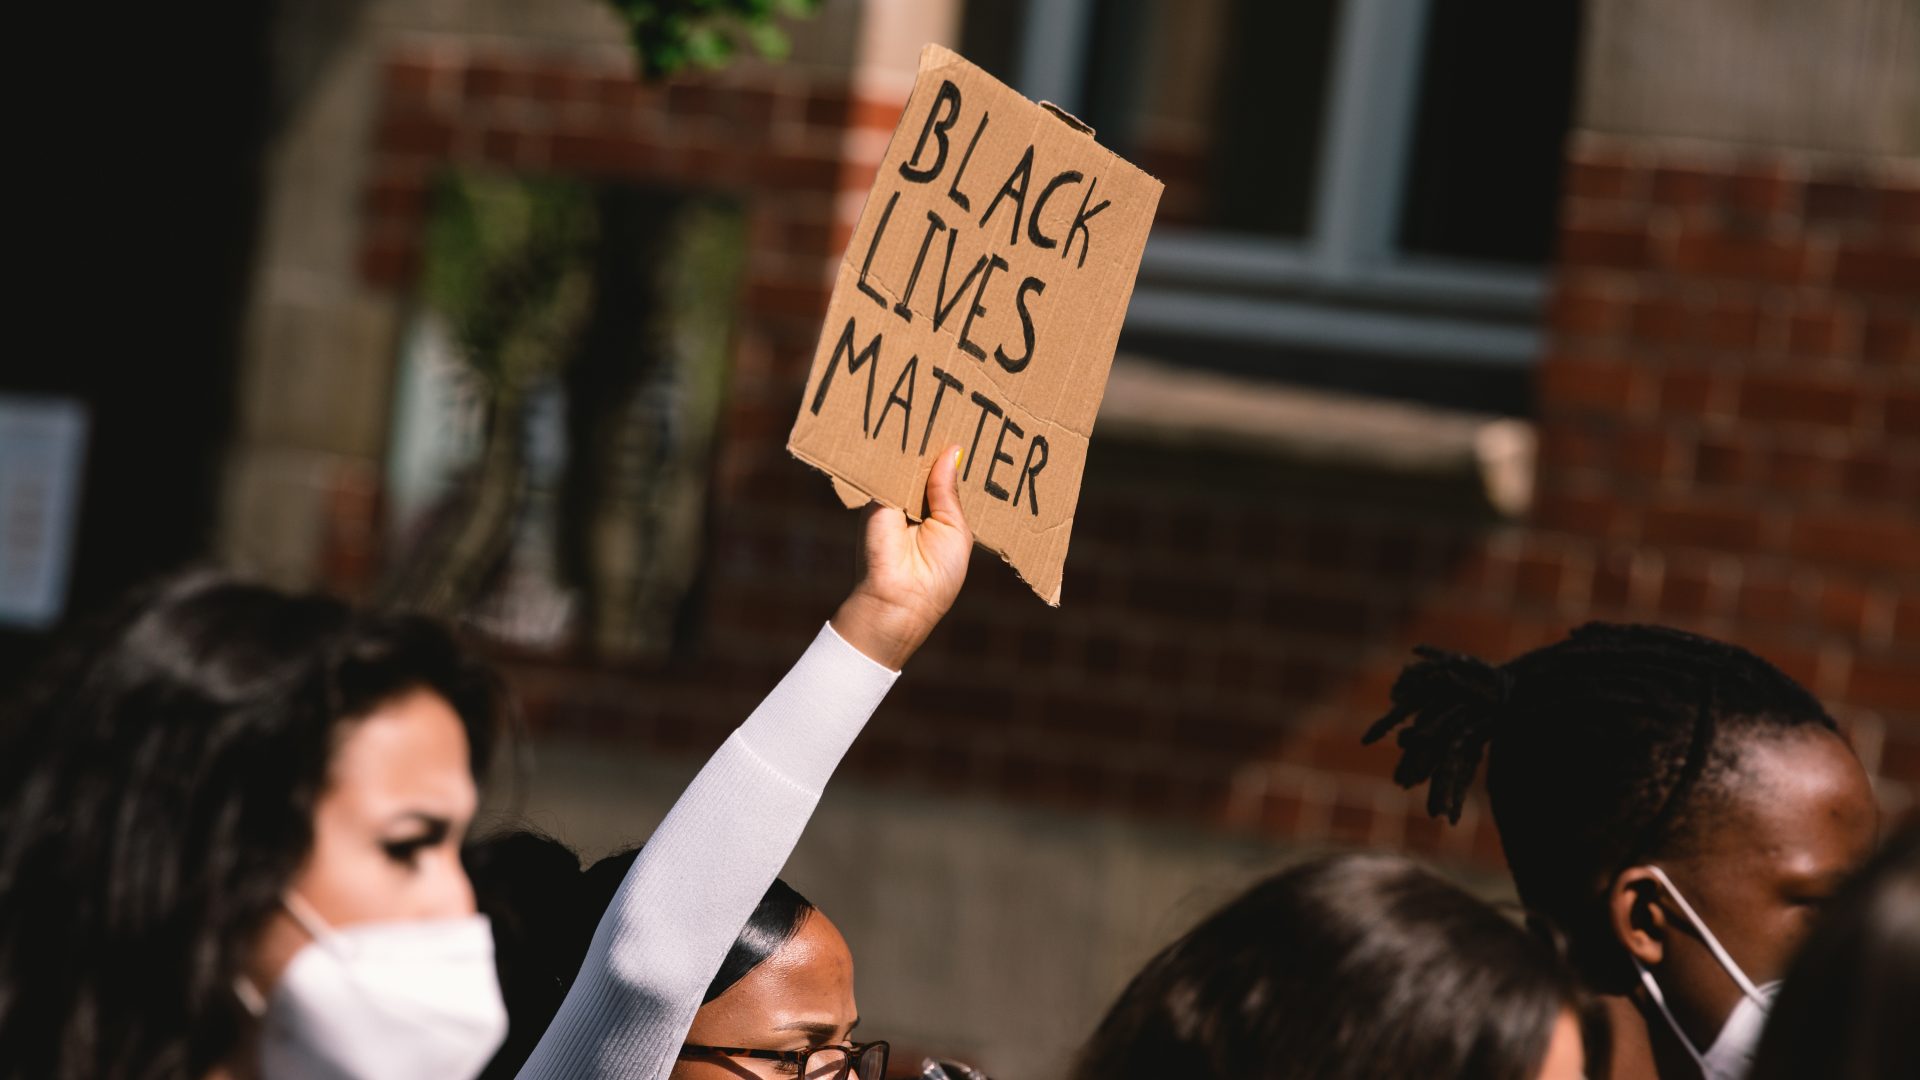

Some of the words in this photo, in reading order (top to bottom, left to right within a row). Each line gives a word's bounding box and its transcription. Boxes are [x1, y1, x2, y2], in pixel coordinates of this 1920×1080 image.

[899, 80, 1111, 269] BLACK
[857, 191, 1047, 374] LIVES
[810, 316, 1049, 517] MATTER
